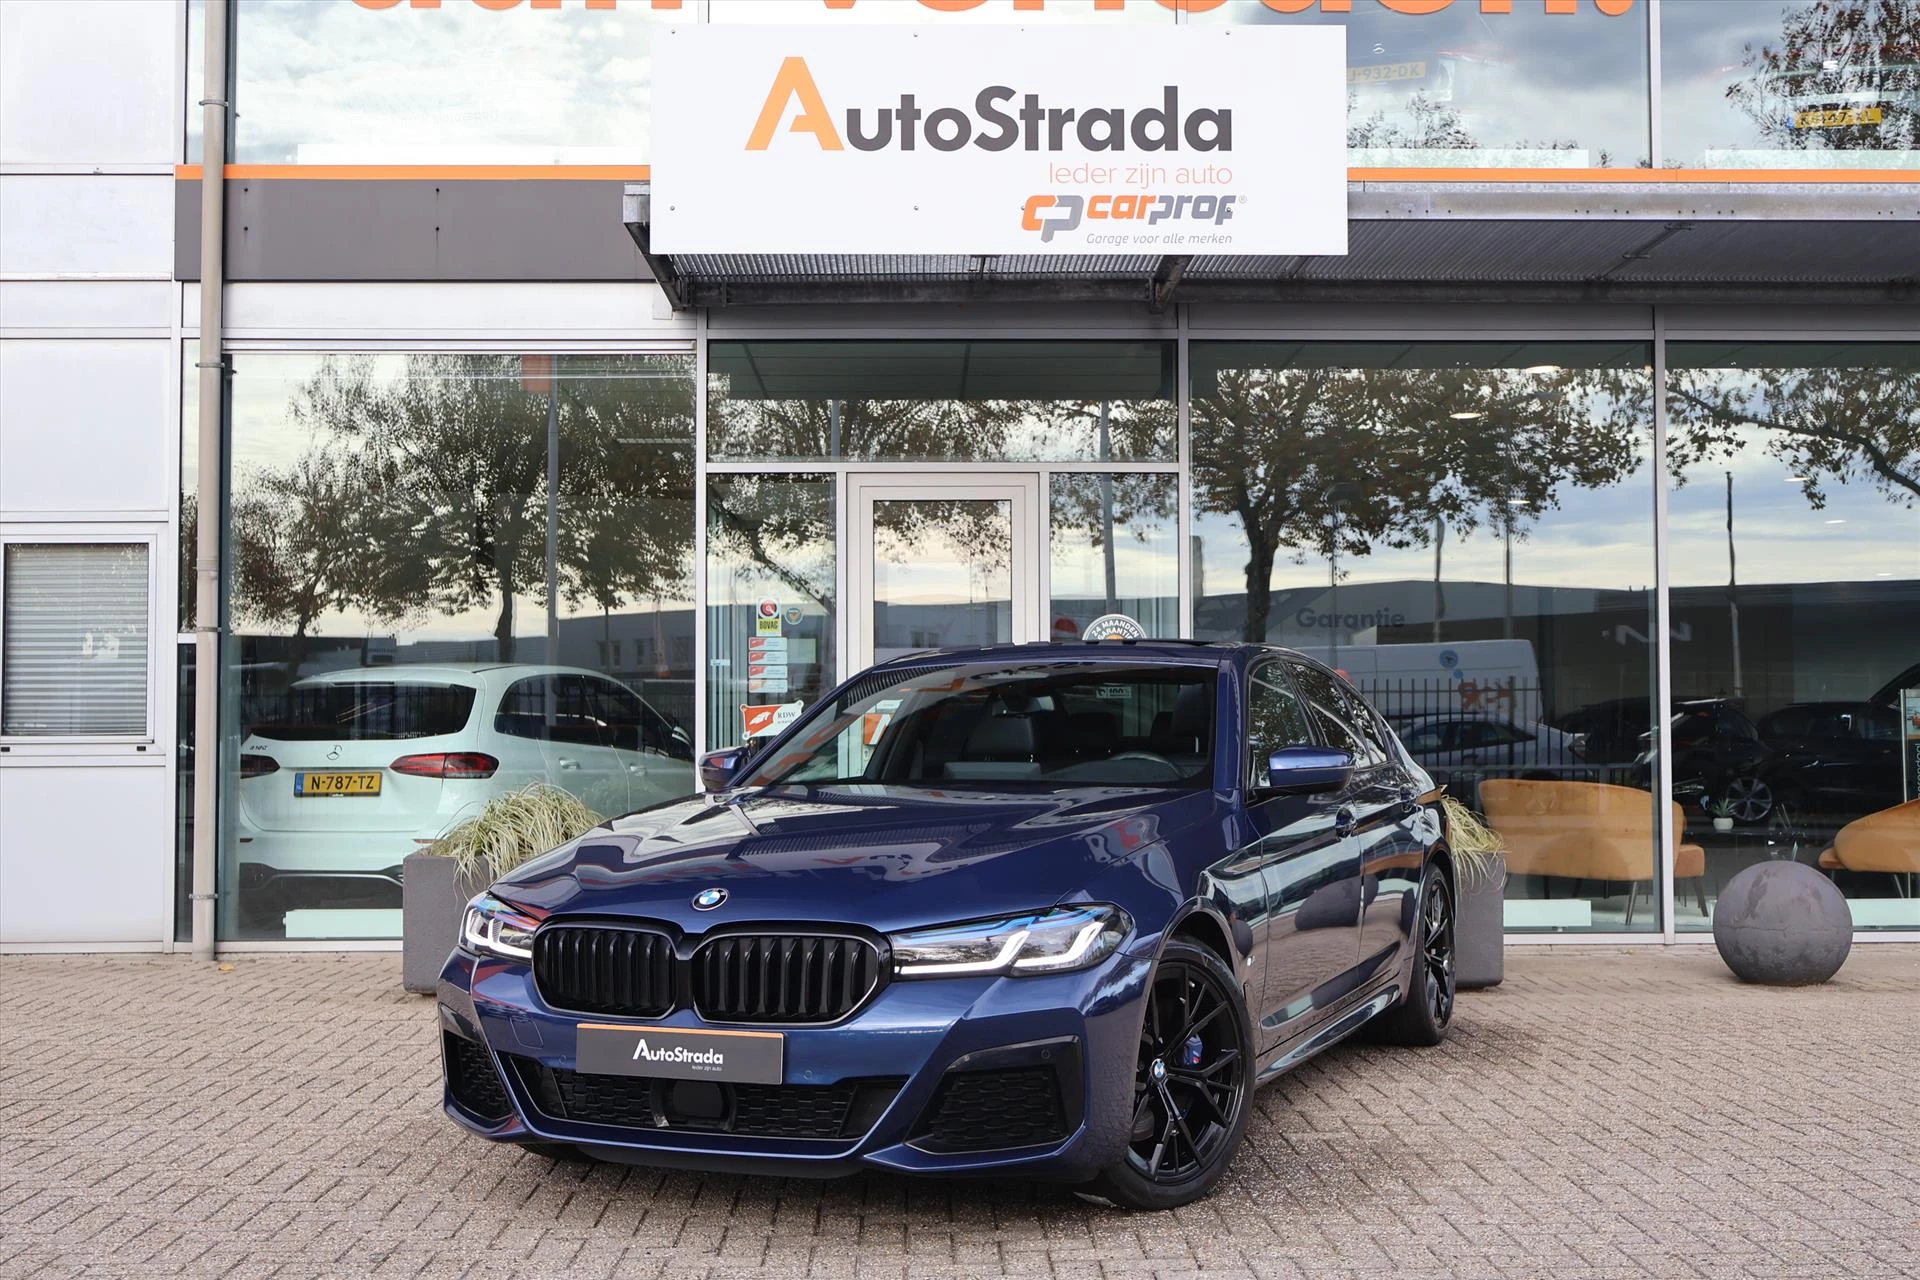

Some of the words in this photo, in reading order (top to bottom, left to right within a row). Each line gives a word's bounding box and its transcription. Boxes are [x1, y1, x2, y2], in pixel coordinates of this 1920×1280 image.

[745, 56, 1233, 153] AutoStrada
[1049, 163, 1118, 185] Ieder
[1125, 163, 1166, 190] zijn
[1175, 163, 1233, 185] auto
[1086, 233, 1129, 247] Garage
[1133, 236, 1160, 244] voor
[1162, 233, 1185, 244] alle
[1188, 233, 1233, 244] merken
[760, 620, 778, 630] BOVAG
[1295, 606, 1405, 629] Garantie
[1091, 626, 1101, 637] 24
[1101, 619, 1140, 638] MAANDEN
[777, 711, 796, 719] RDW
[311, 775, 375, 790] N-787-TZ
[632, 1038, 724, 1064] AutoStrada
